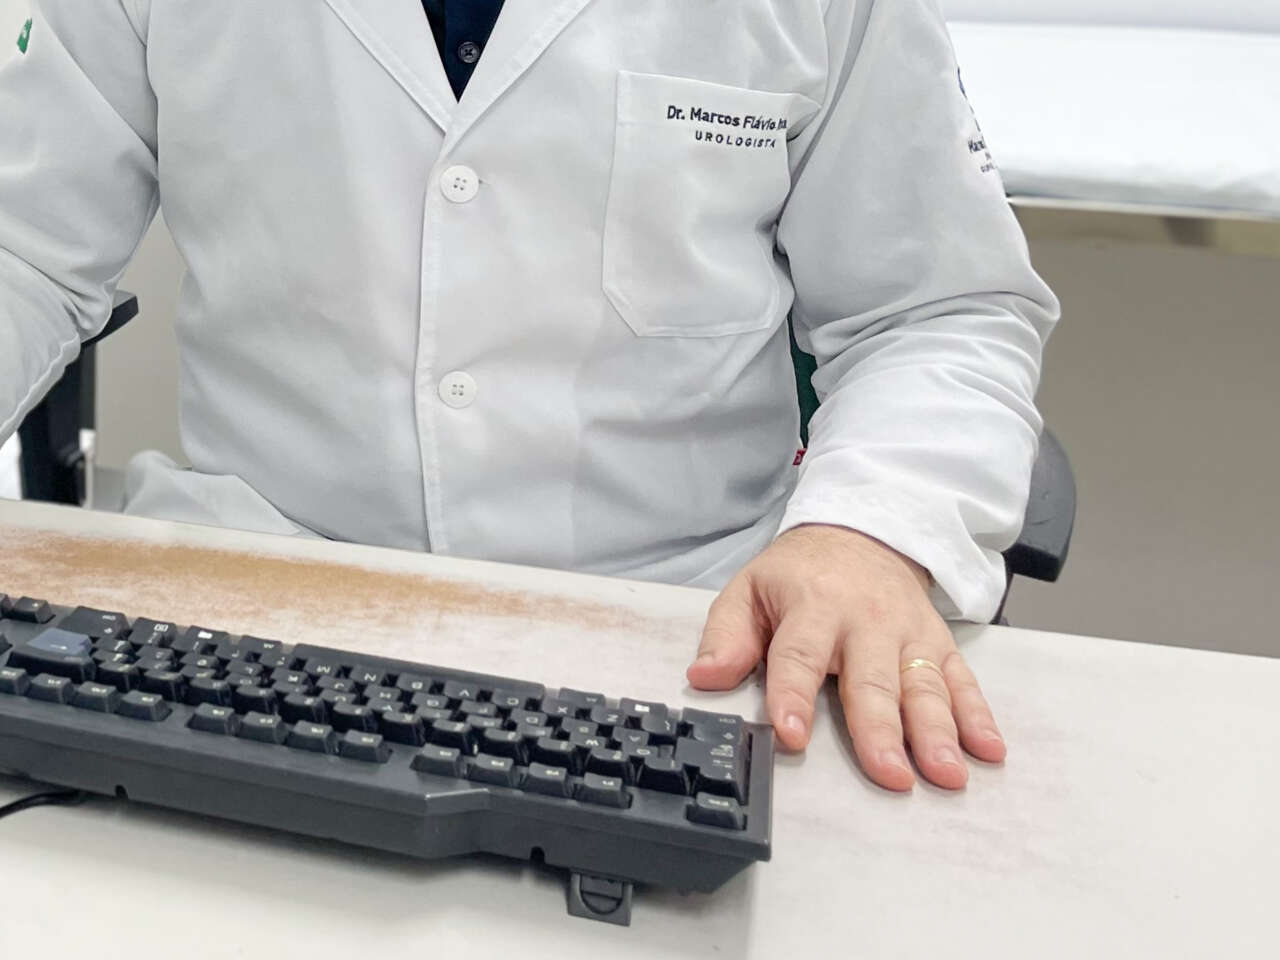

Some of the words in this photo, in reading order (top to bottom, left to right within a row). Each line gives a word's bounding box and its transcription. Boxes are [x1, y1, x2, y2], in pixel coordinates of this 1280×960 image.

[667, 105, 685, 121] Dr.
[690, 107, 740, 127] Marcos
[695, 130, 776, 148] UROLOGISTA
